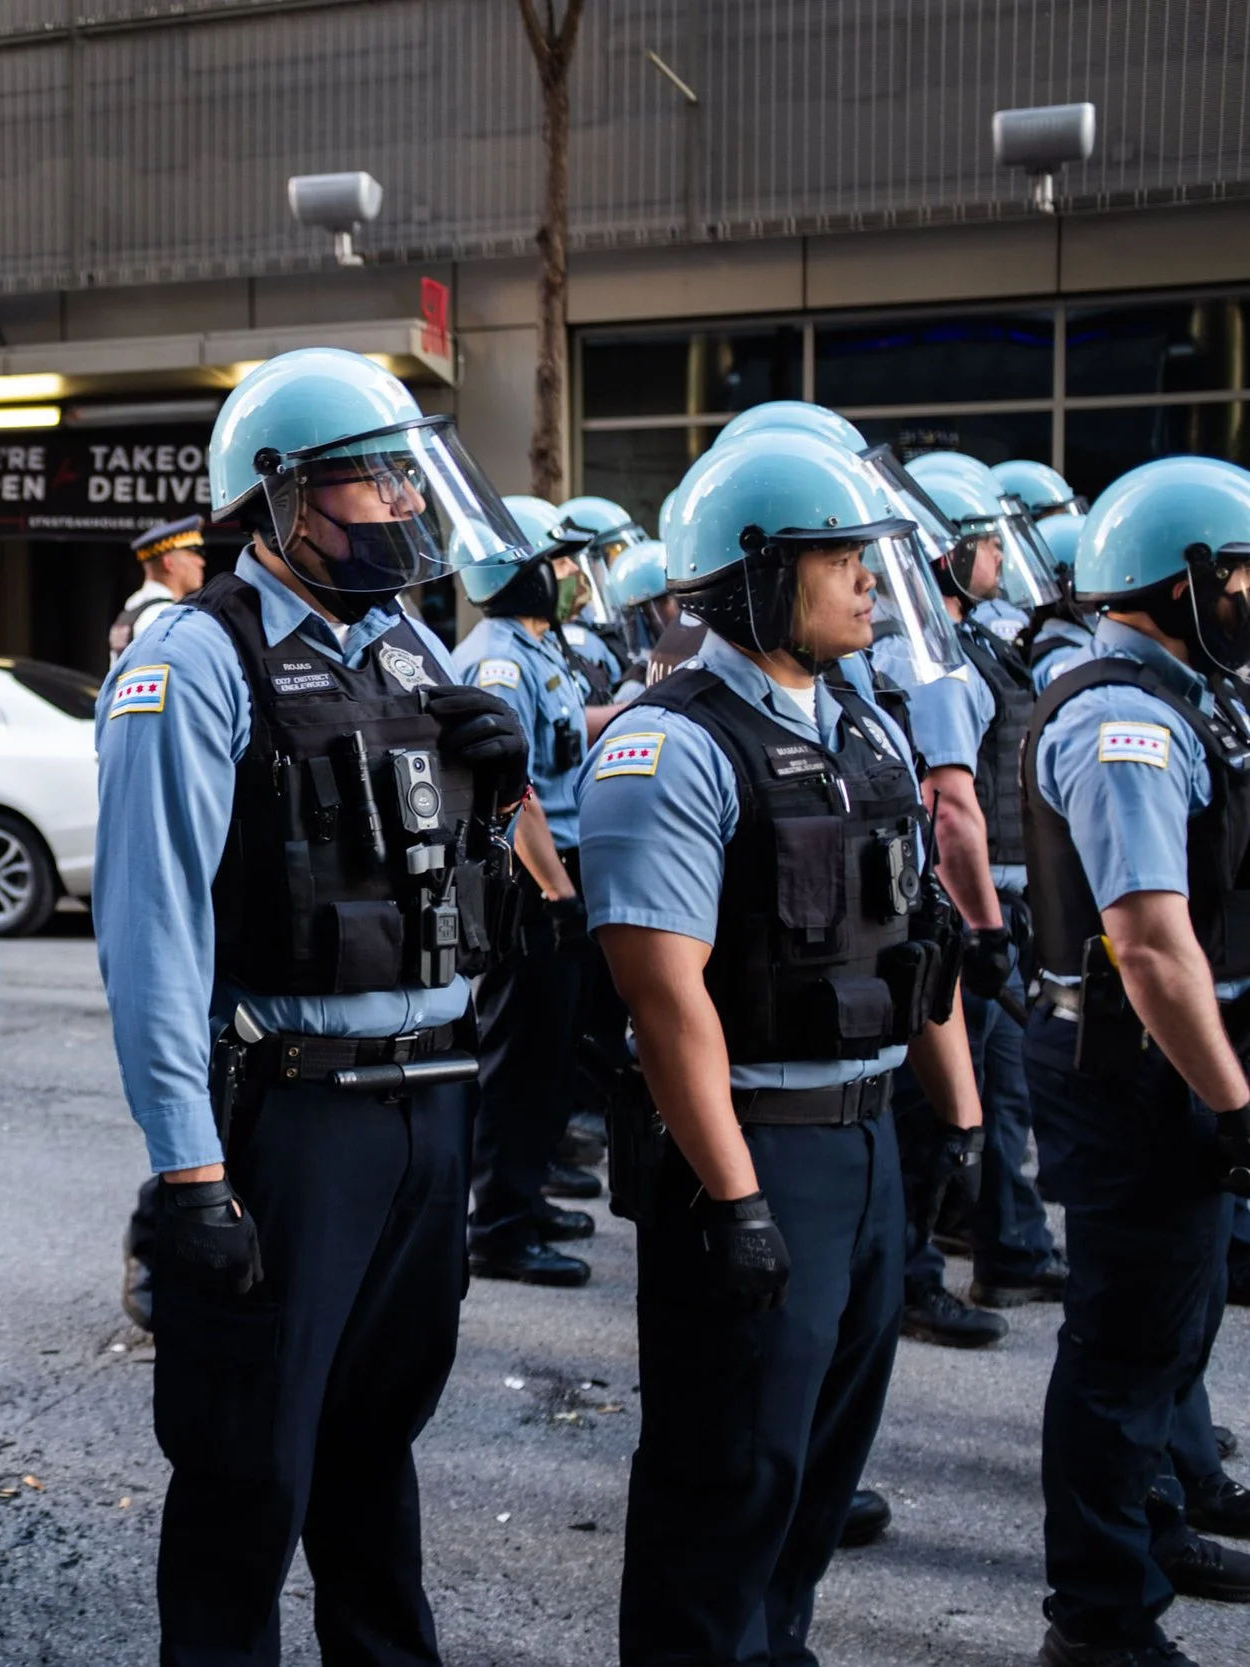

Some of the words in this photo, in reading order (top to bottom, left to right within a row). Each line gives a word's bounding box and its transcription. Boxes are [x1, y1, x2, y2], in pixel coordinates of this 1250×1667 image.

[89, 445, 210, 471] TAKEO
[87, 474, 211, 503] DELIVE
[282, 662, 312, 671] ROJAS
[293, 673, 329, 684] DISTRICT
[280, 680, 330, 692] ENGLEWOOD
